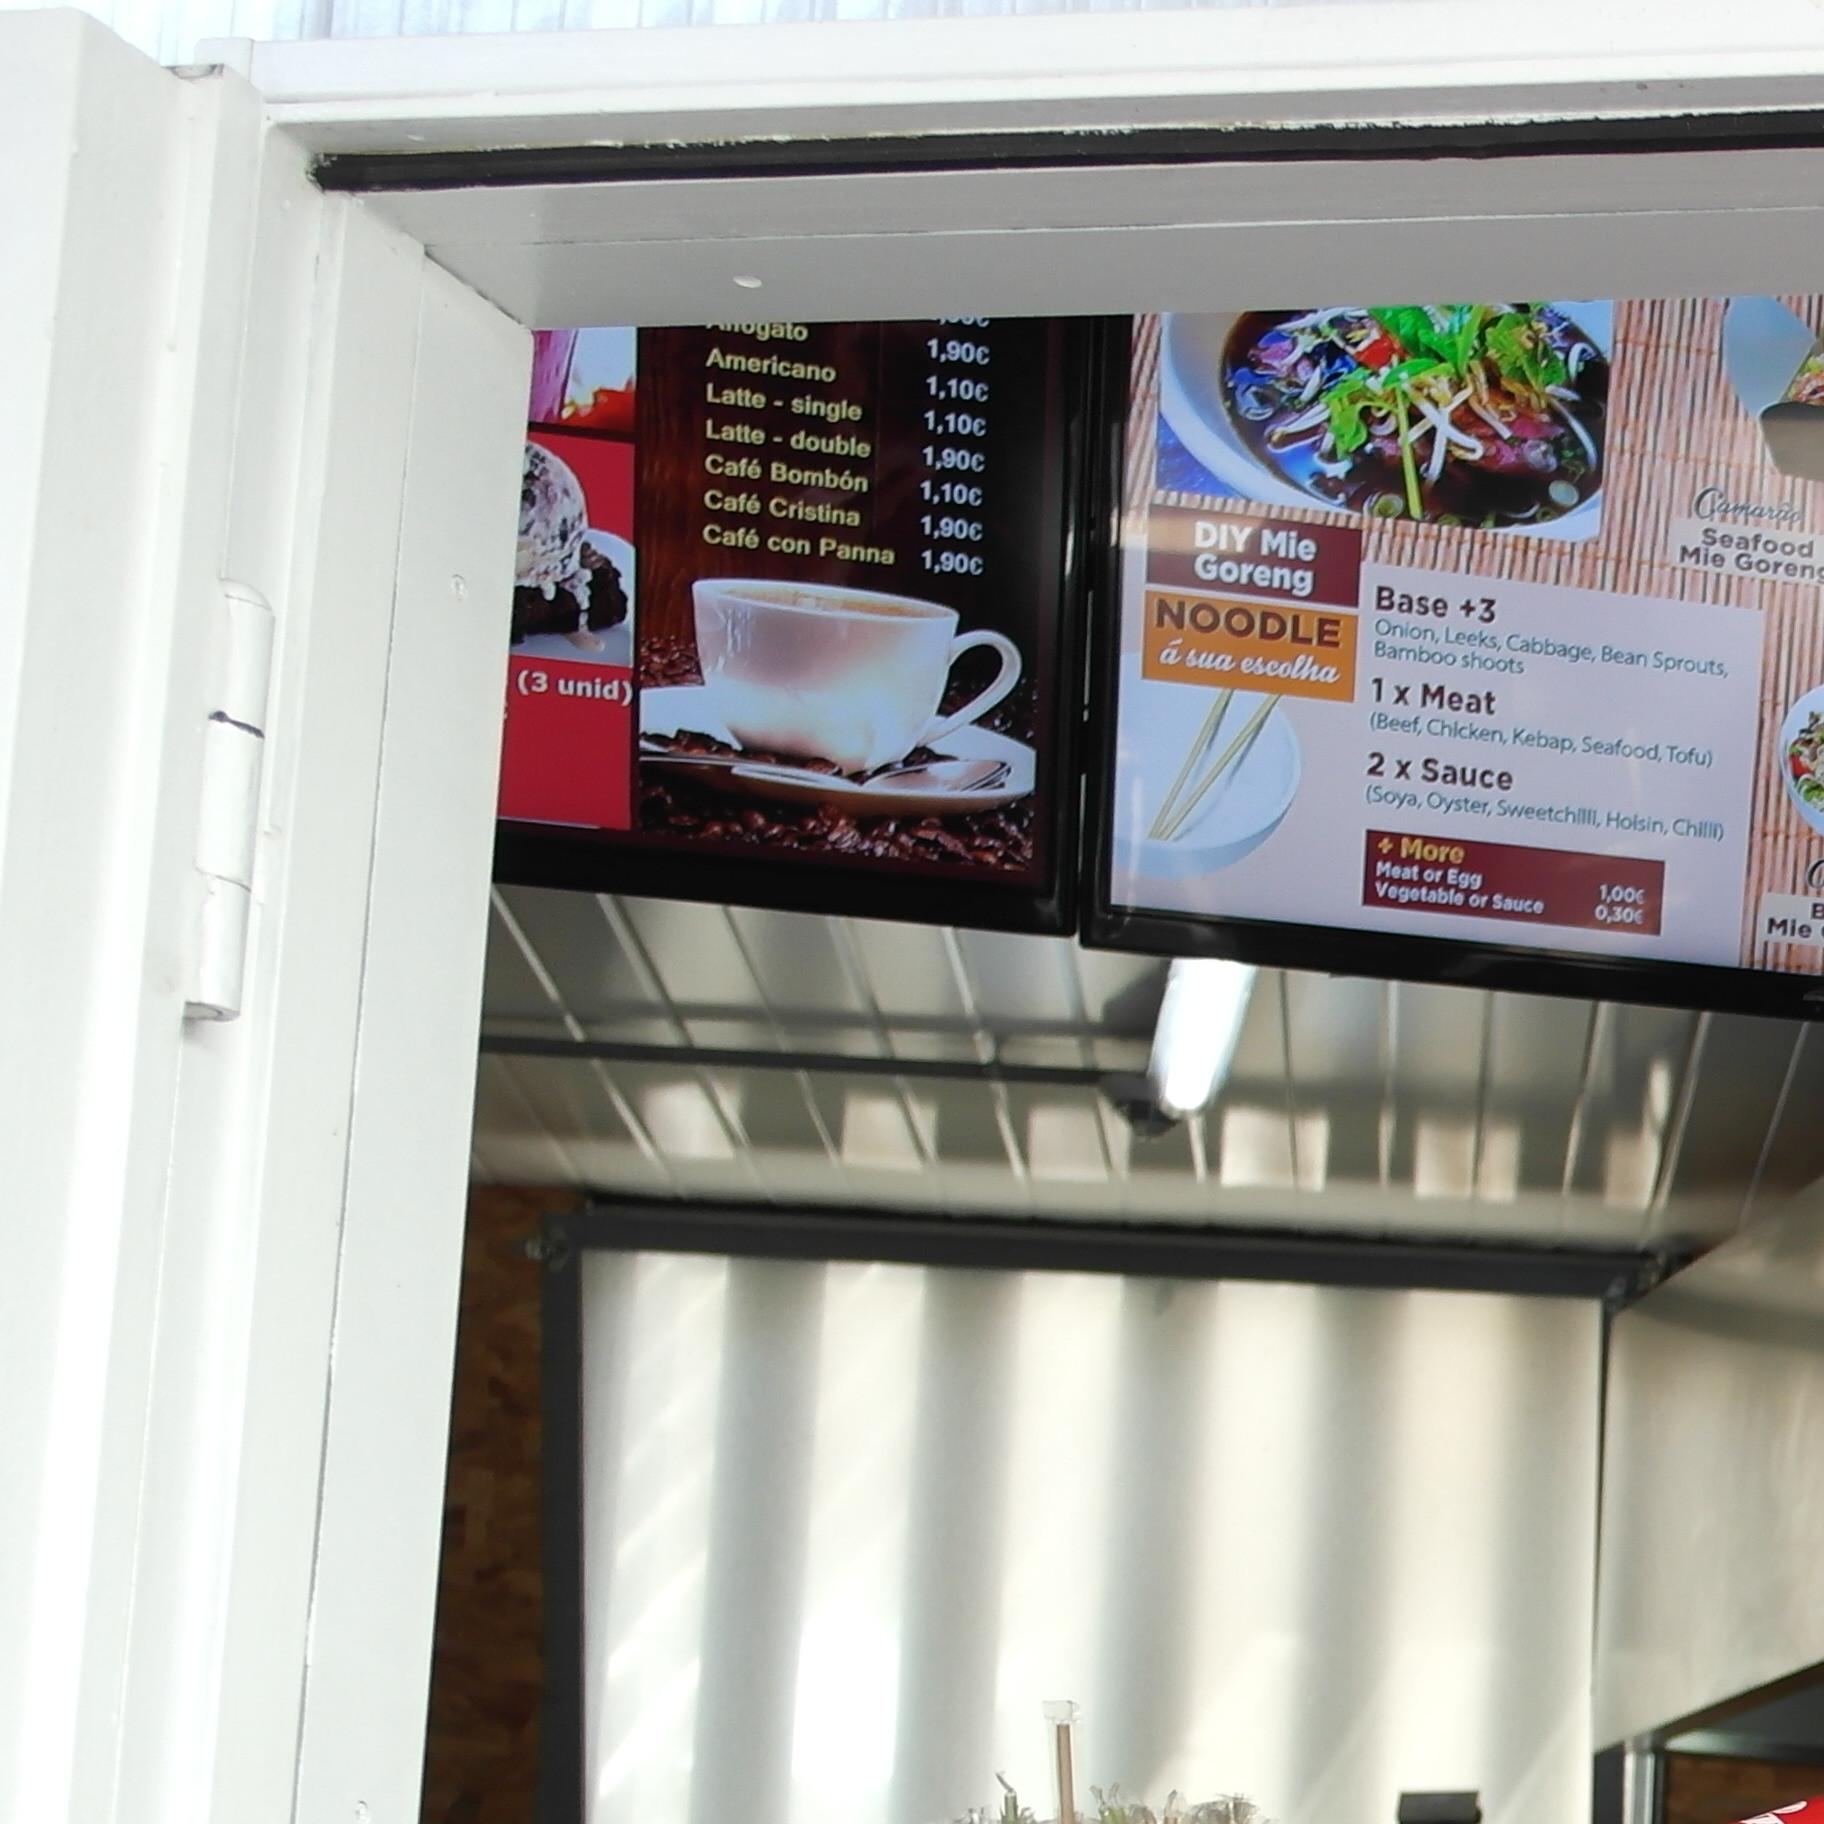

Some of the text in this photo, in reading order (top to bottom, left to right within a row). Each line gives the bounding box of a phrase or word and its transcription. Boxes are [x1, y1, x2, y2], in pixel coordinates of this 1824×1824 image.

[927, 338, 990, 365] 1,90€
[706, 348, 989, 402] Americano 1,10€
[706, 383, 766, 409] Latte
[791, 395, 863, 422] single
[924, 410, 987, 437] 1,10€
[706, 419, 765, 444] Latte
[790, 429, 871, 458] double
[922, 445, 985, 472] 1,90€
[705, 454, 982, 507] Café Bombón 1,10€
[704, 489, 983, 542] Café Cristina 1,90€
[1694, 487, 1802, 524] Camarão
[702, 523, 759, 549] Café
[767, 536, 811, 556] con
[820, 537, 896, 566] Panna
[1194, 521, 1318, 562] DIY Mie
[1679, 544, 1725, 568] Mie
[1702, 527, 1814, 558] Seafood
[1194, 553, 1314, 597] Goreng
[1155, 598, 1342, 649] NOODLE
[1375, 585, 1497, 624] Base +3
[1186, 649, 1236, 672] sua
[1240, 655, 1340, 684] escolha
[1374, 640, 1525, 674] Bamboo shoots
[1375, 618, 1729, 679] Onion, Leeks, Cabbage, Bean Sprouts,
[518, 670, 633, 706] (3 unid)
[1372, 678, 1496, 715] 1 x Meat
[1370, 711, 1713, 768] (Beef, Chicken, Kebap, Seafood, Tofu)
[1367, 752, 1513, 791] 2 x Sauce
[1366, 784, 1423, 810] (Soya,
[1427, 791, 1493, 818] Oyster,
[1606, 812, 1668, 835] Hoisin,
[1673, 818, 1724, 842] Chilli)
[1378, 837, 1465, 864] + More
[1375, 881, 1643, 925] Vegetable or Sauce 0,30€
[1376, 860, 1645, 905] Meat or Egg 1,00€
[1767, 917, 1812, 939] Mie
